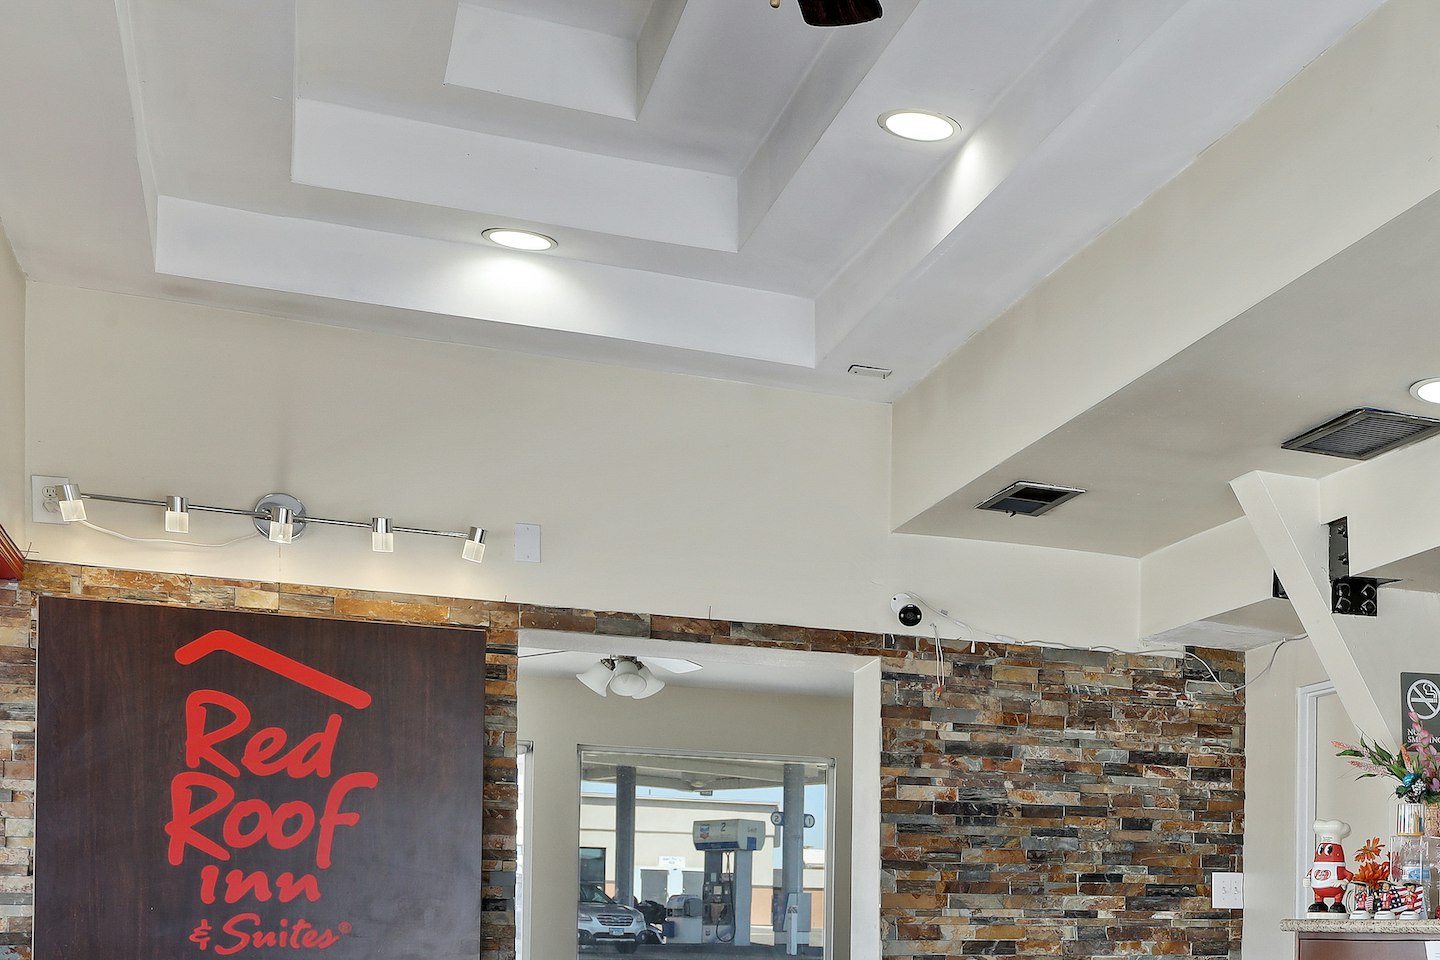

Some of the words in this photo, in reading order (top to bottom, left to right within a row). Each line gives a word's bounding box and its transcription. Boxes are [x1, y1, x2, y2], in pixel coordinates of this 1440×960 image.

[185, 689, 342, 778] Red
[164, 772, 378, 869] Roof
[720, 823, 726, 831] 2
[200, 864, 321, 904] Inn
[189, 920, 212, 950] &
